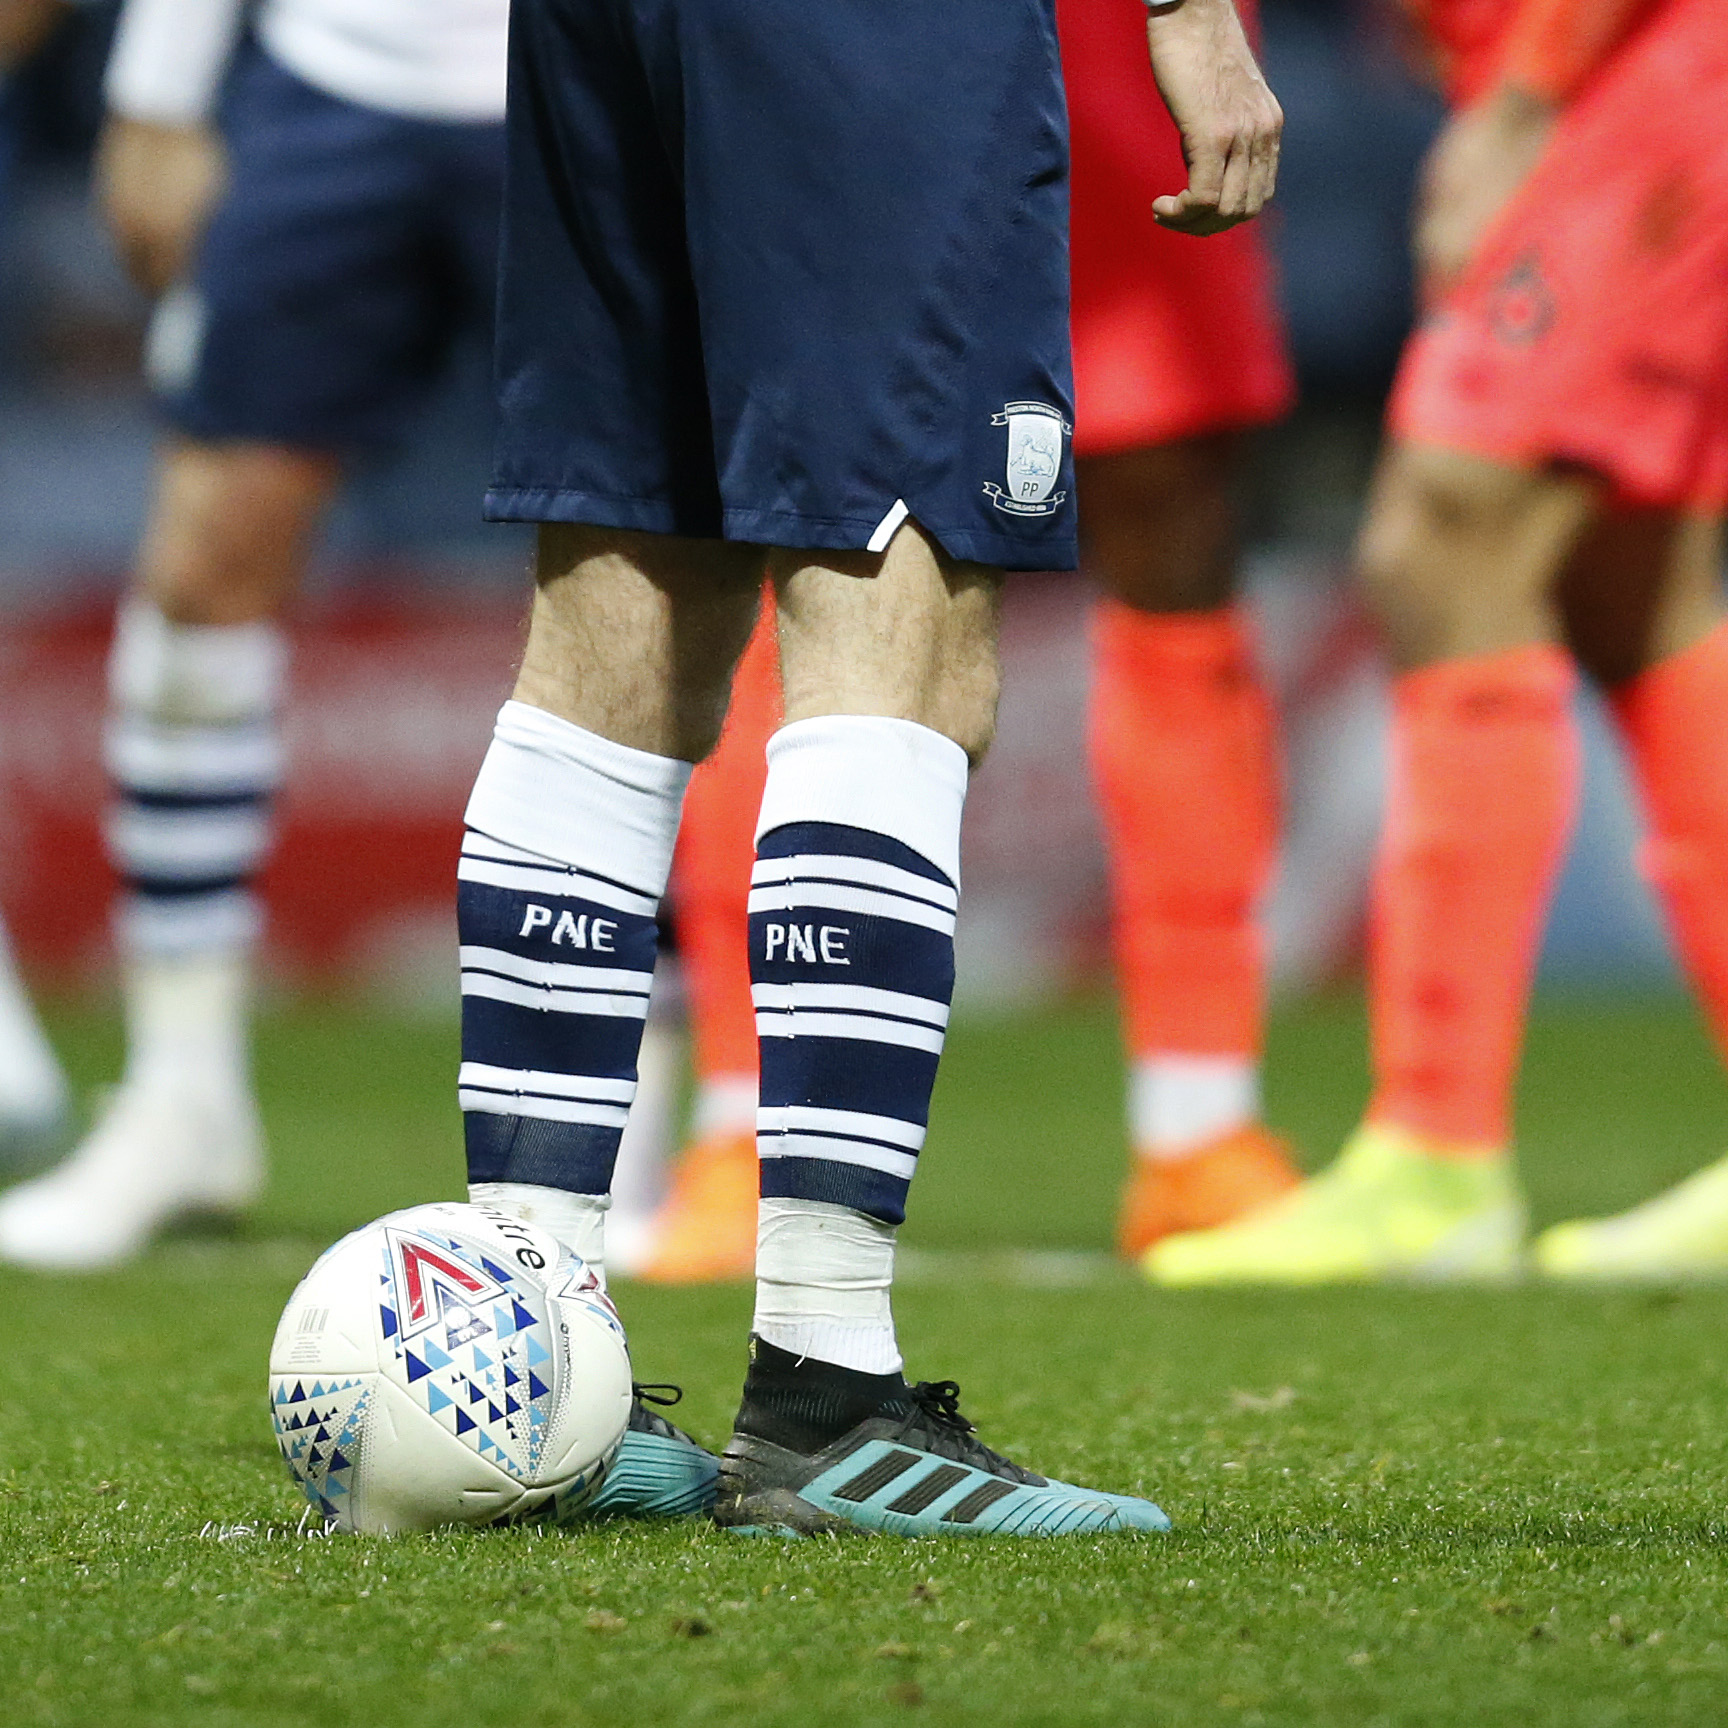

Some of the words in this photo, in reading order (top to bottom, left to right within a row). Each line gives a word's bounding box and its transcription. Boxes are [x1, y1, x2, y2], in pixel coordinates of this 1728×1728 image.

[1021, 481, 1039, 497] PP
[518, 903, 619, 952] PNE
[765, 923, 851, 965] PNE
